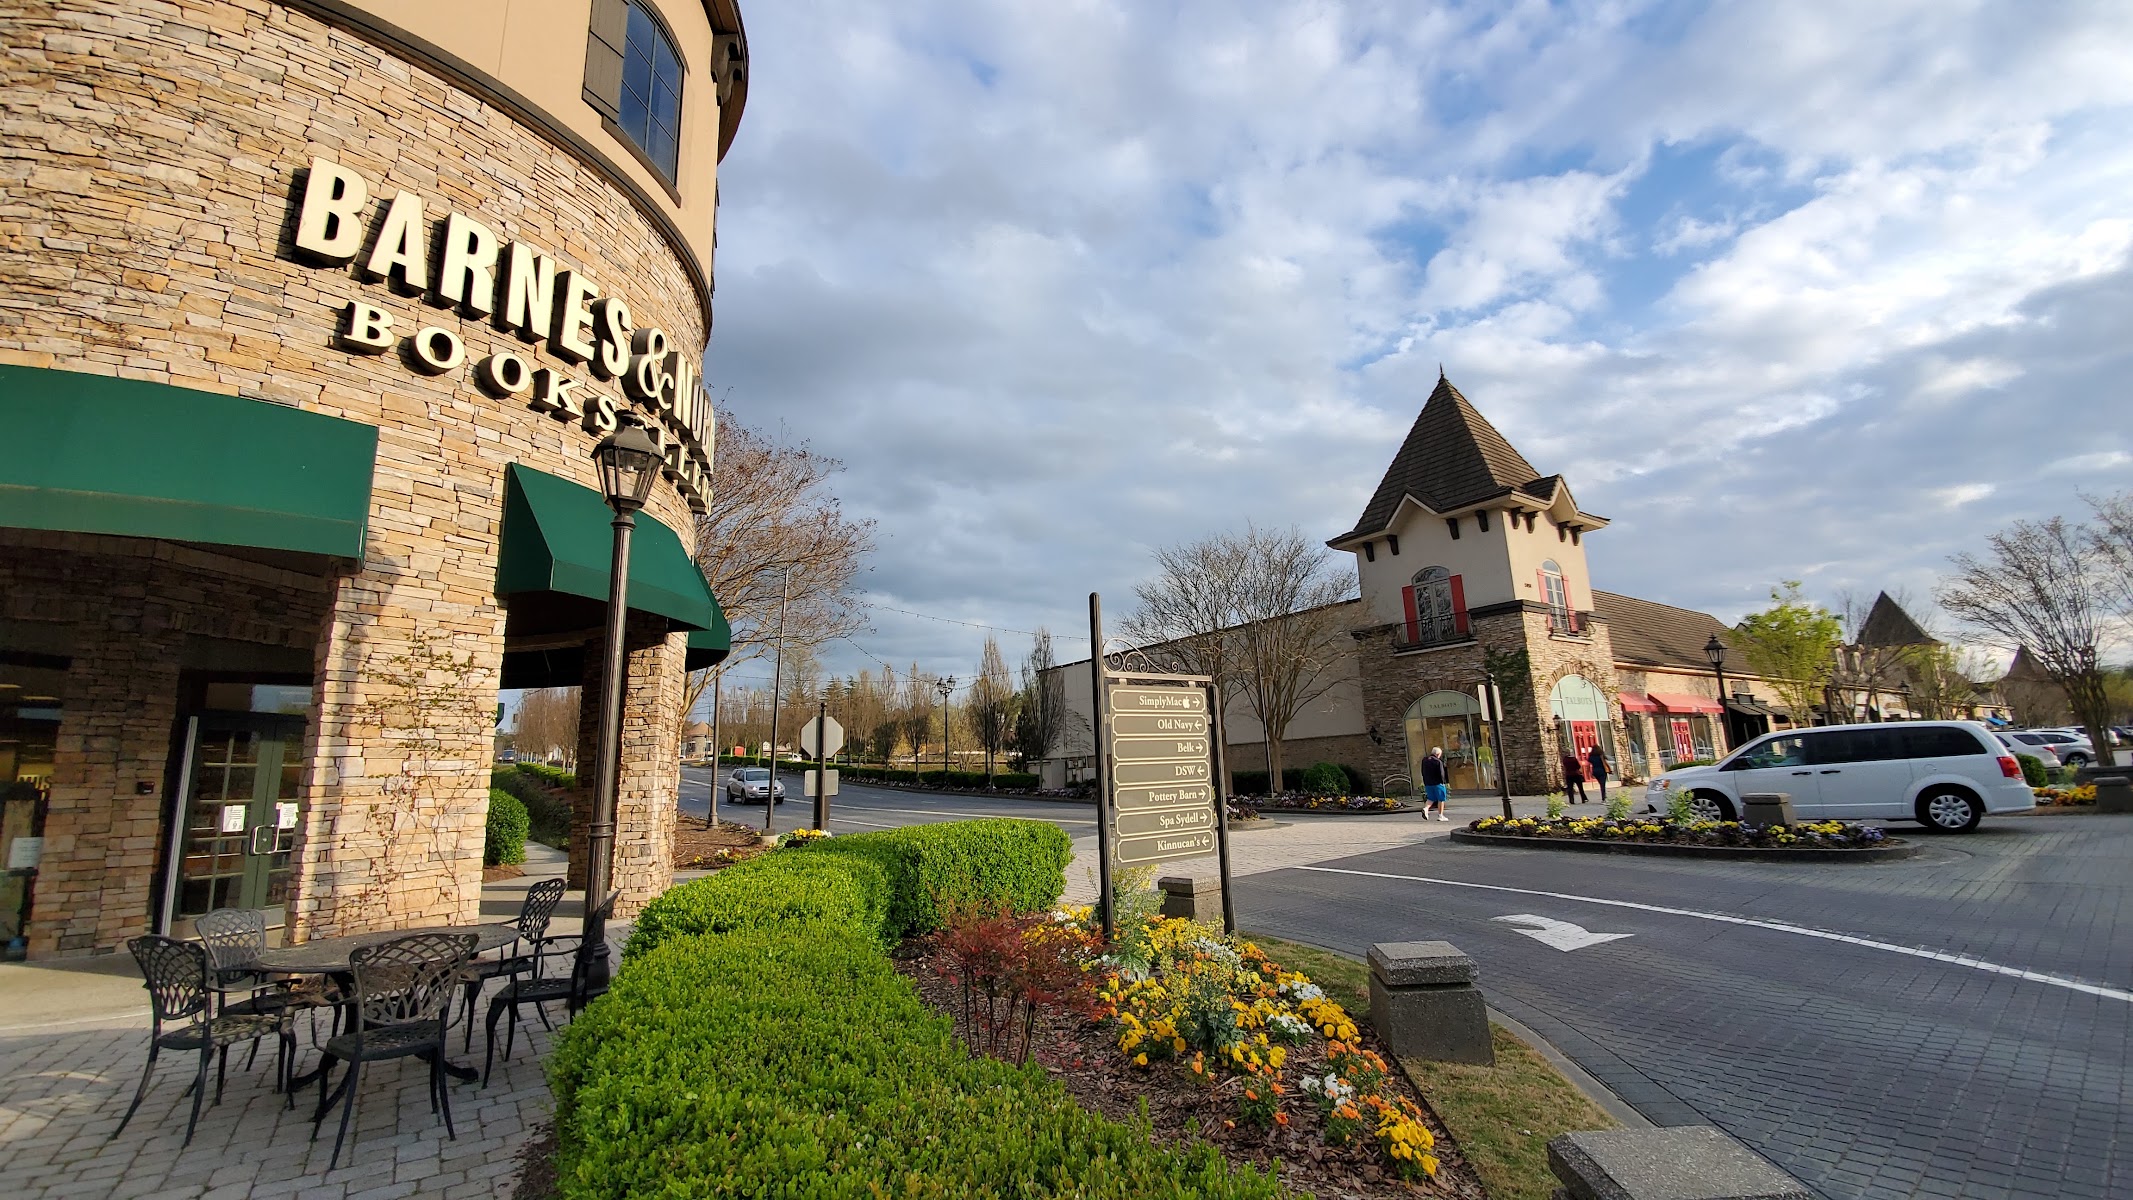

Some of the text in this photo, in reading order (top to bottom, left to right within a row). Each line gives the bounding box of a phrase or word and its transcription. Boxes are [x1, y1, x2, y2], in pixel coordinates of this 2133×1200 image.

[295, 155, 632, 378] BARNES
[635, 327, 675, 410] &
[343, 300, 715, 517] BOOKSLLERS
[1139, 695, 1182, 709] SimplyMac
[1429, 702, 1457, 710] TALBOTS
[1565, 696, 1593, 705] TALBOTS
[1157, 719, 1194, 732] Old Navy
[1177, 742, 1194, 753] Belk
[1175, 765, 1196, 776] DSW
[1149, 788, 1197, 803] Pottery Barn
[1159, 812, 1199, 826] Spa Sydell
[1157, 837, 1200, 851] Kinnucan's
